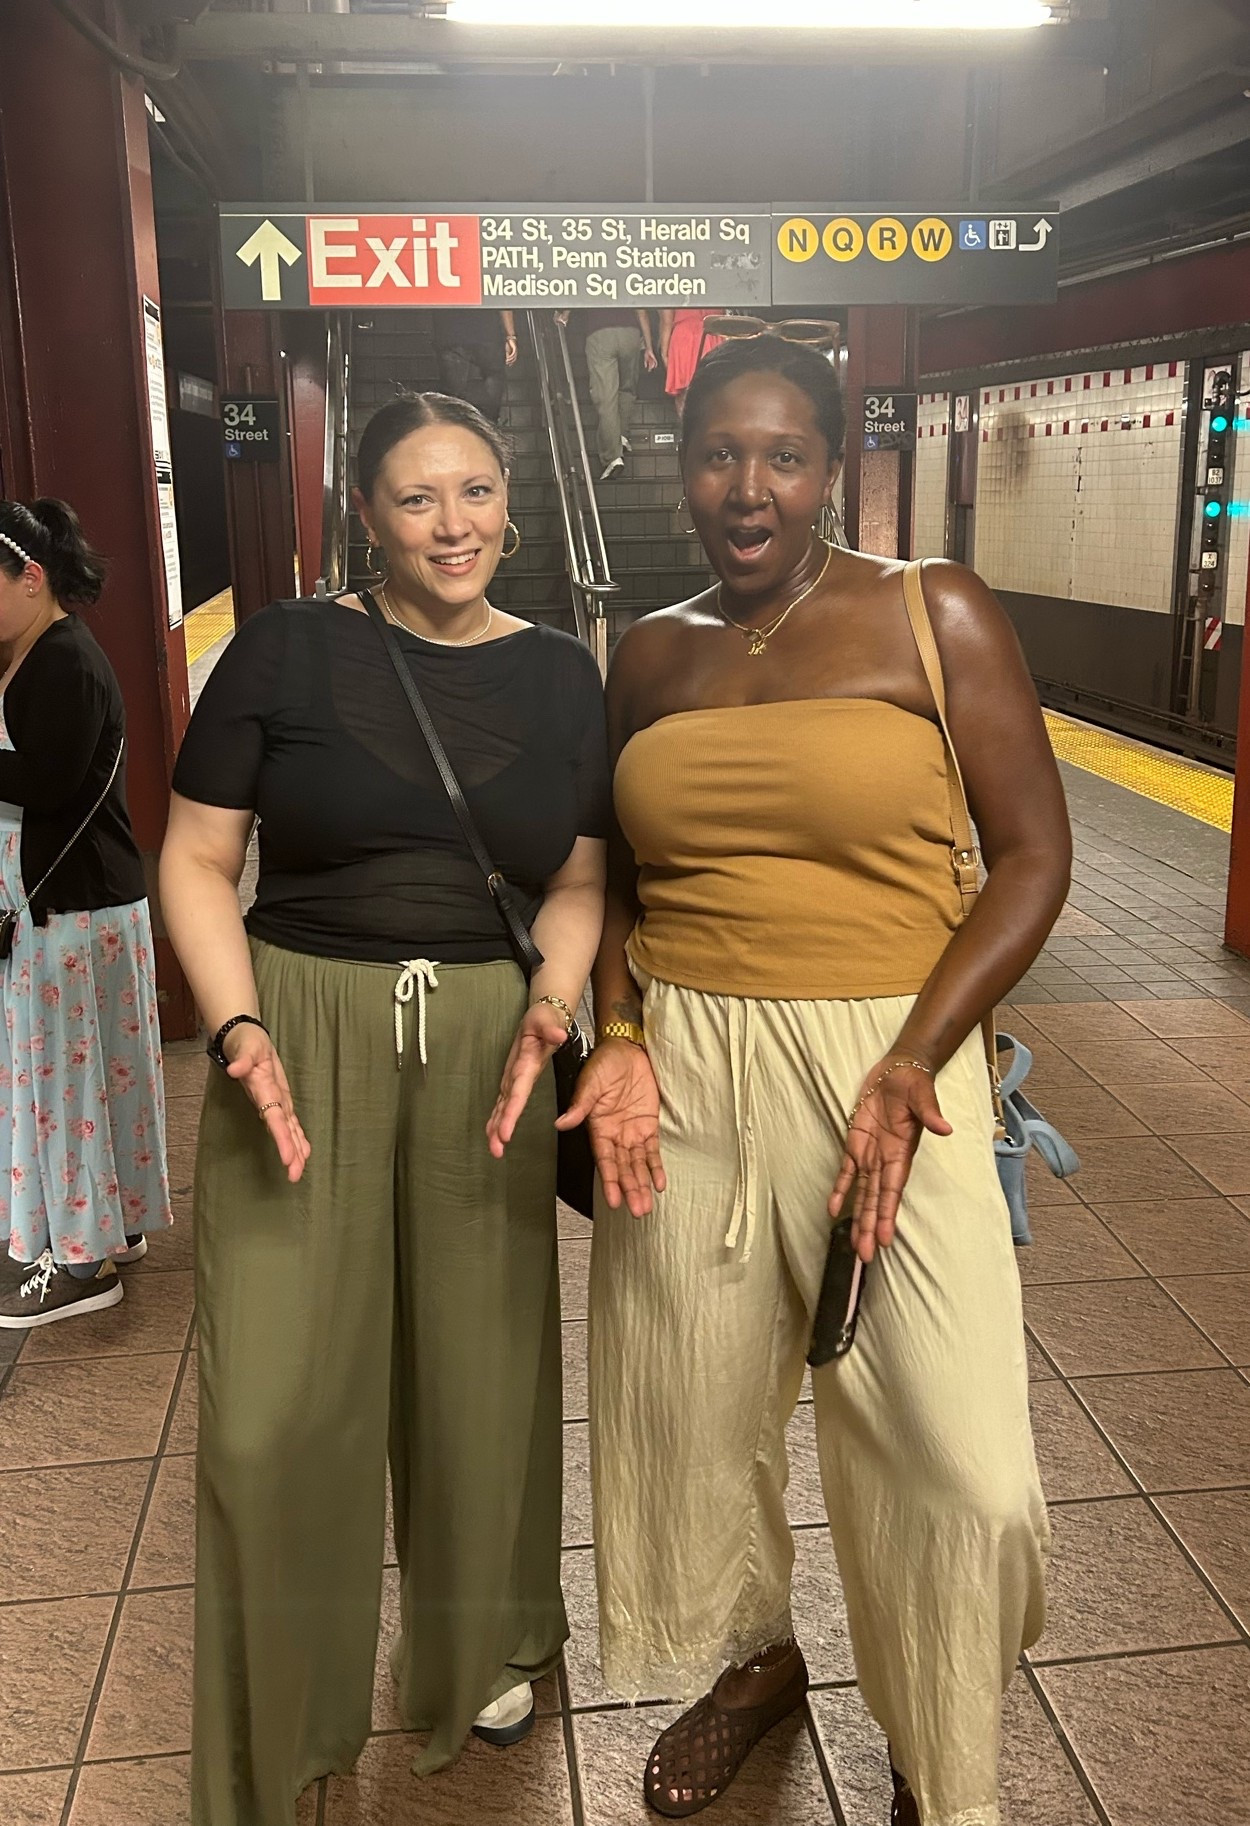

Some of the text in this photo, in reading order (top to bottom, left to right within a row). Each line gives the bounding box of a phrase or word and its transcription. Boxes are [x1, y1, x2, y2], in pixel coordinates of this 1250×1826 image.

[482, 218, 750, 245] 34 St, 35 St, Herald Sq
[788, 227, 946, 252] N Q R W
[309, 218, 461, 288] Exit
[482, 245, 695, 272] PATH, Penn Station
[483, 273, 706, 300] Madison Sq Garden
[223, 403, 256, 426] 34
[864, 396, 895, 418] 34
[224, 428, 269, 441] Street
[864, 420, 905, 433] Street
